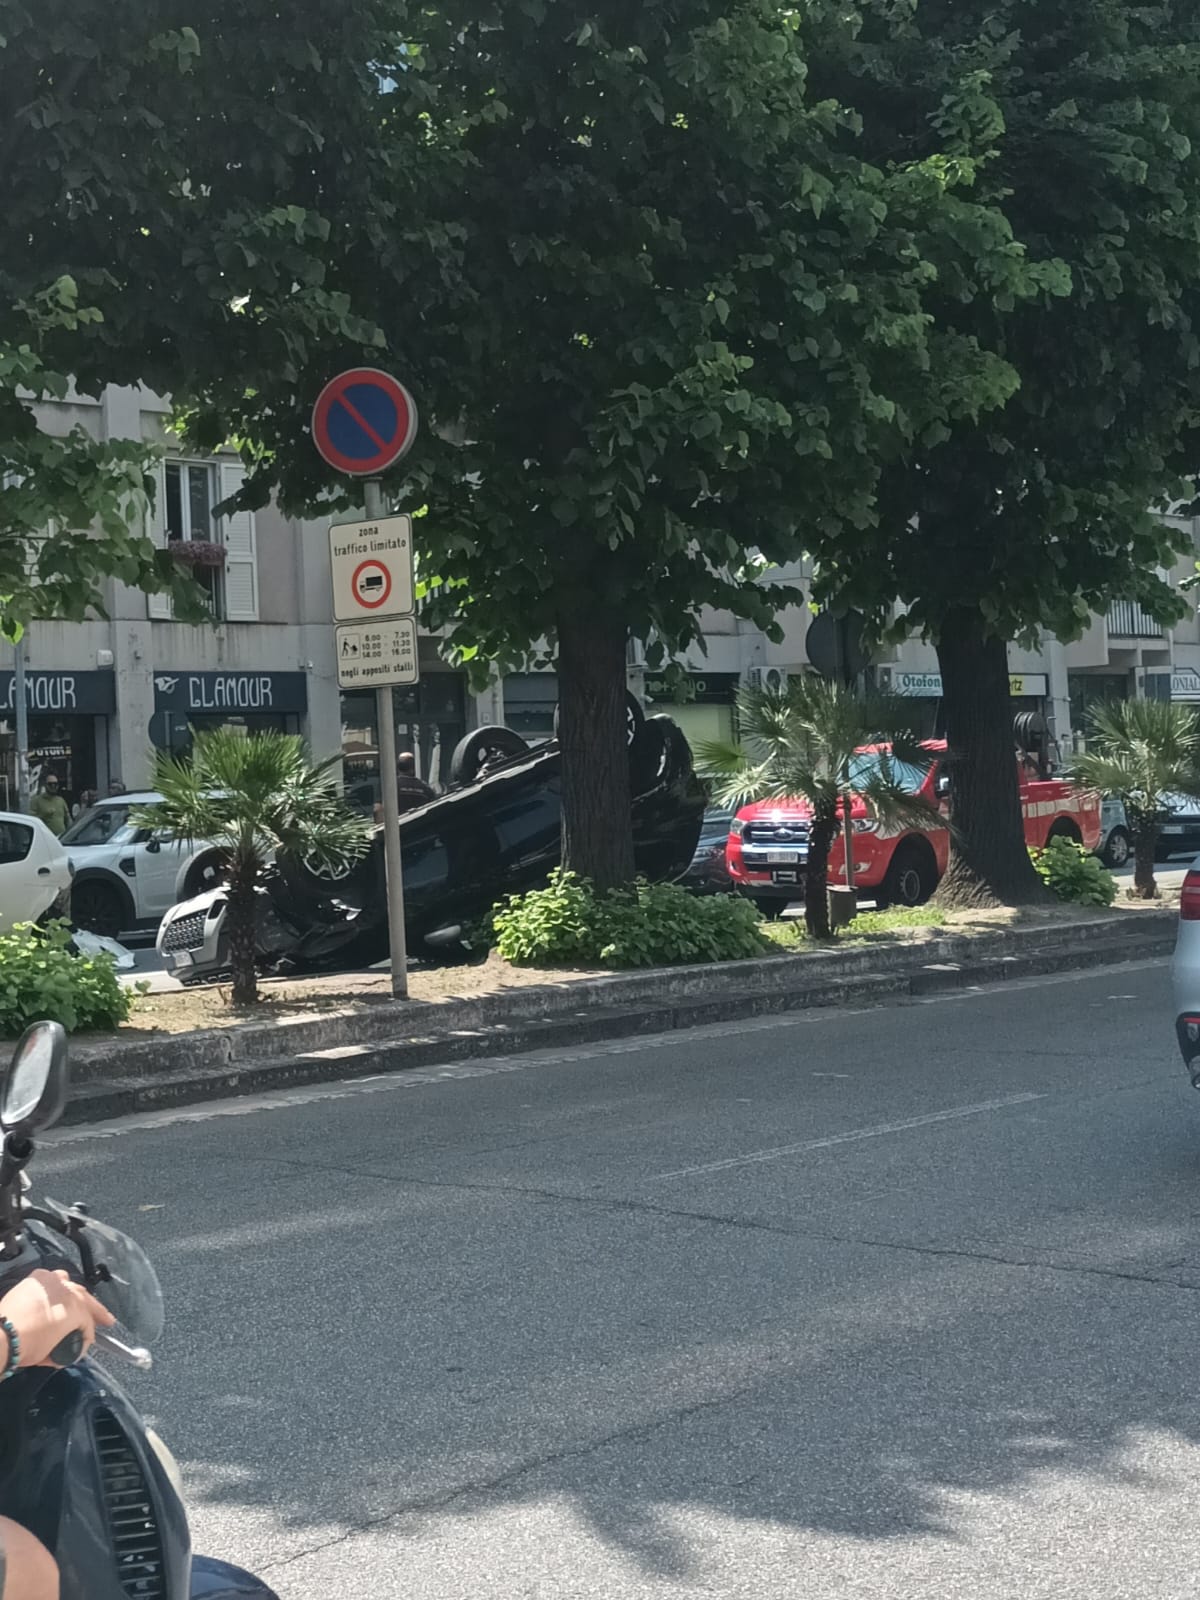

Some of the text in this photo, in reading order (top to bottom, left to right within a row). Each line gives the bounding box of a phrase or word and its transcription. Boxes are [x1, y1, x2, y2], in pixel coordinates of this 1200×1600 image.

[359, 526, 379, 537] zona
[334, 538, 407, 557] traffico limitato
[341, 661, 414, 678] negli appositi stalli
[188, 676, 273, 708] GLAMOUR
